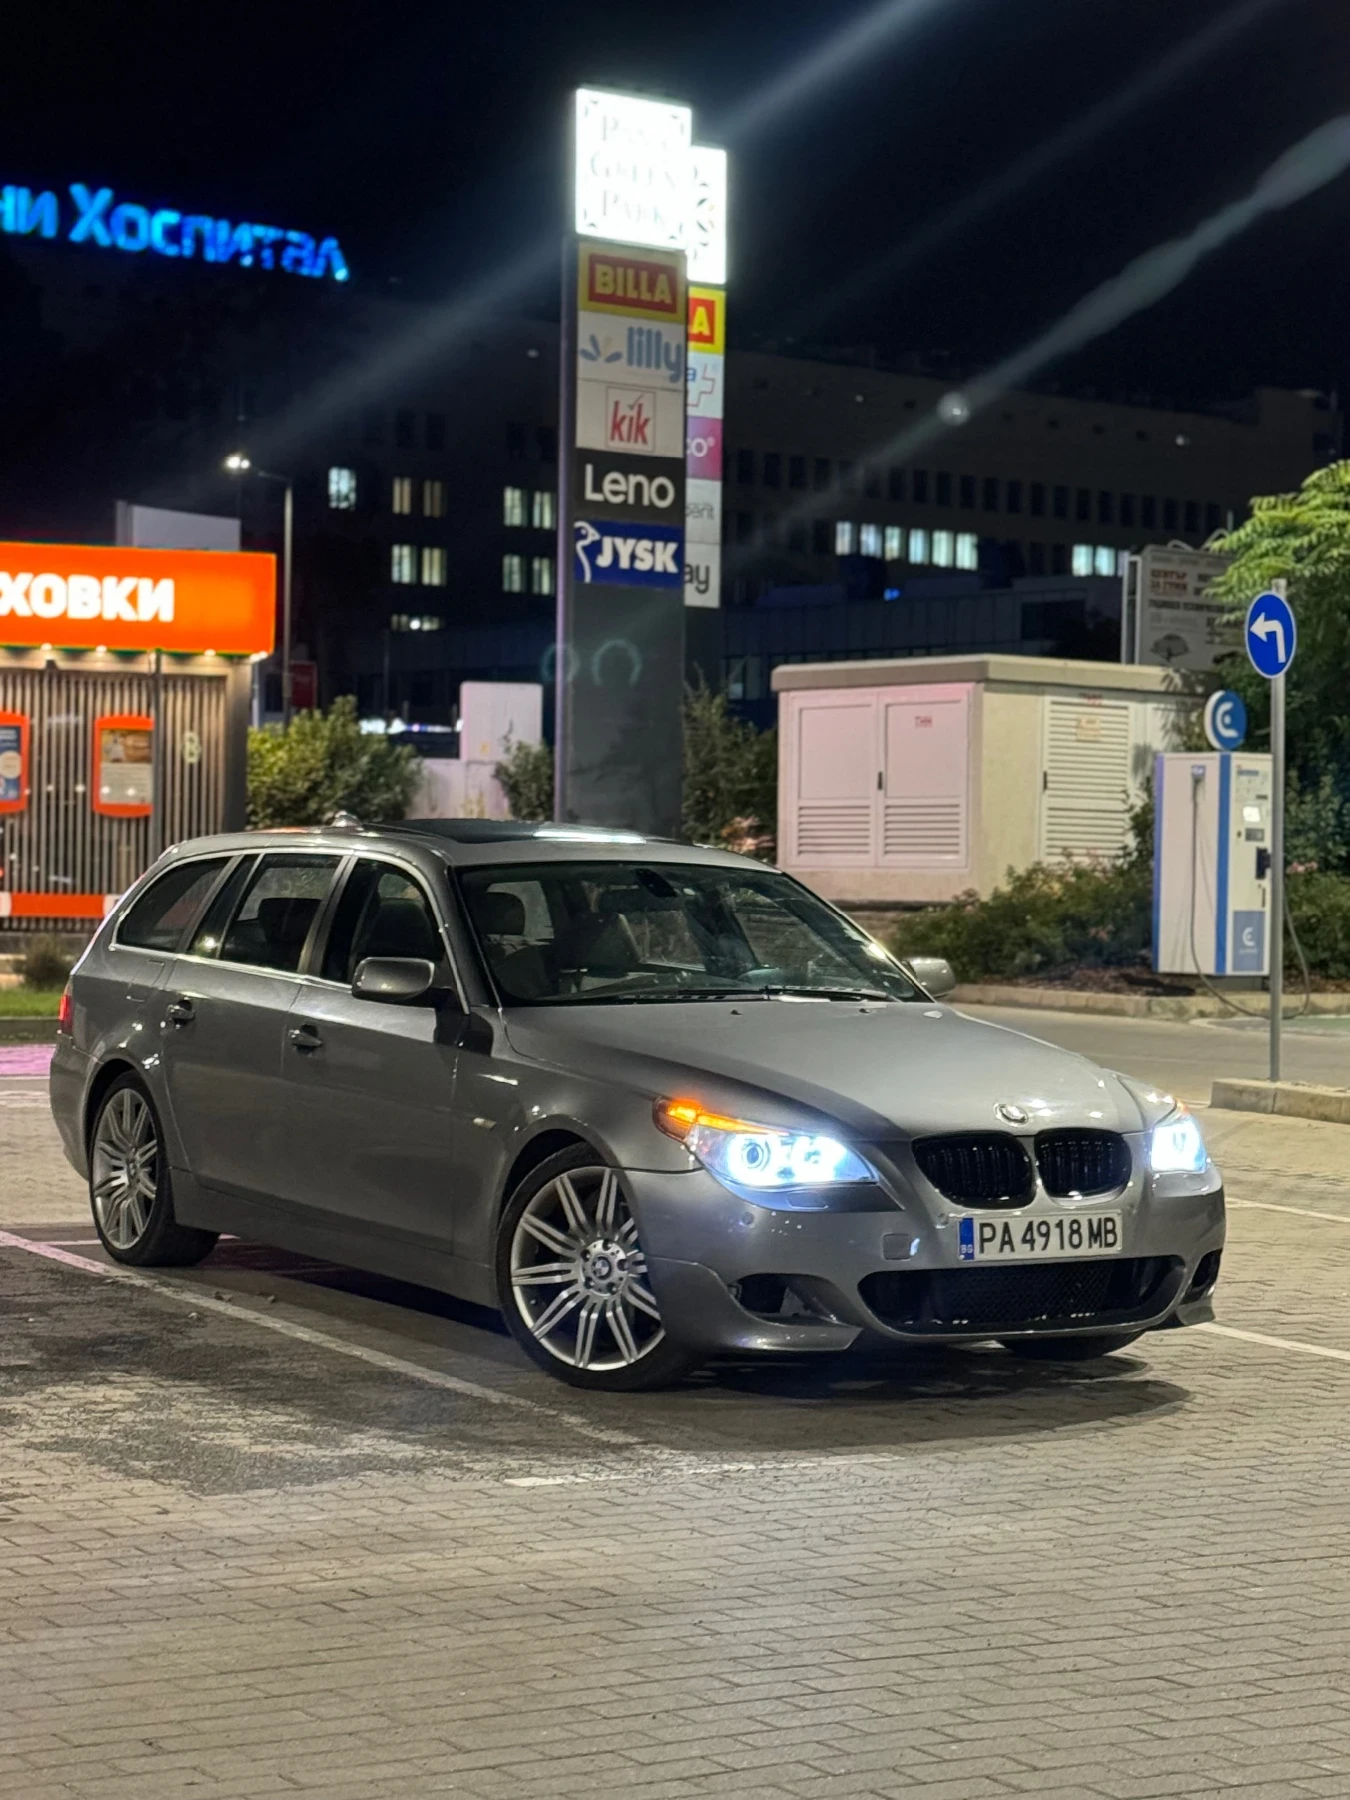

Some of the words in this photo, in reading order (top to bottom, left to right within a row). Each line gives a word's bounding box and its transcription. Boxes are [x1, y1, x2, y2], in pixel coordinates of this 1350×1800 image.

[594, 262, 673, 305] BILLA
[690, 305, 712, 337] A
[626, 325, 683, 383] lilly
[610, 400, 650, 444] kik
[584, 463, 675, 509] Leno
[596, 535, 679, 574] JYSK
[0, 571, 175, 623] ХОВКИ
[979, 1221, 1015, 1254] PA
[1021, 1219, 1083, 1251] 4918
[1087, 1216, 1117, 1249] MB
